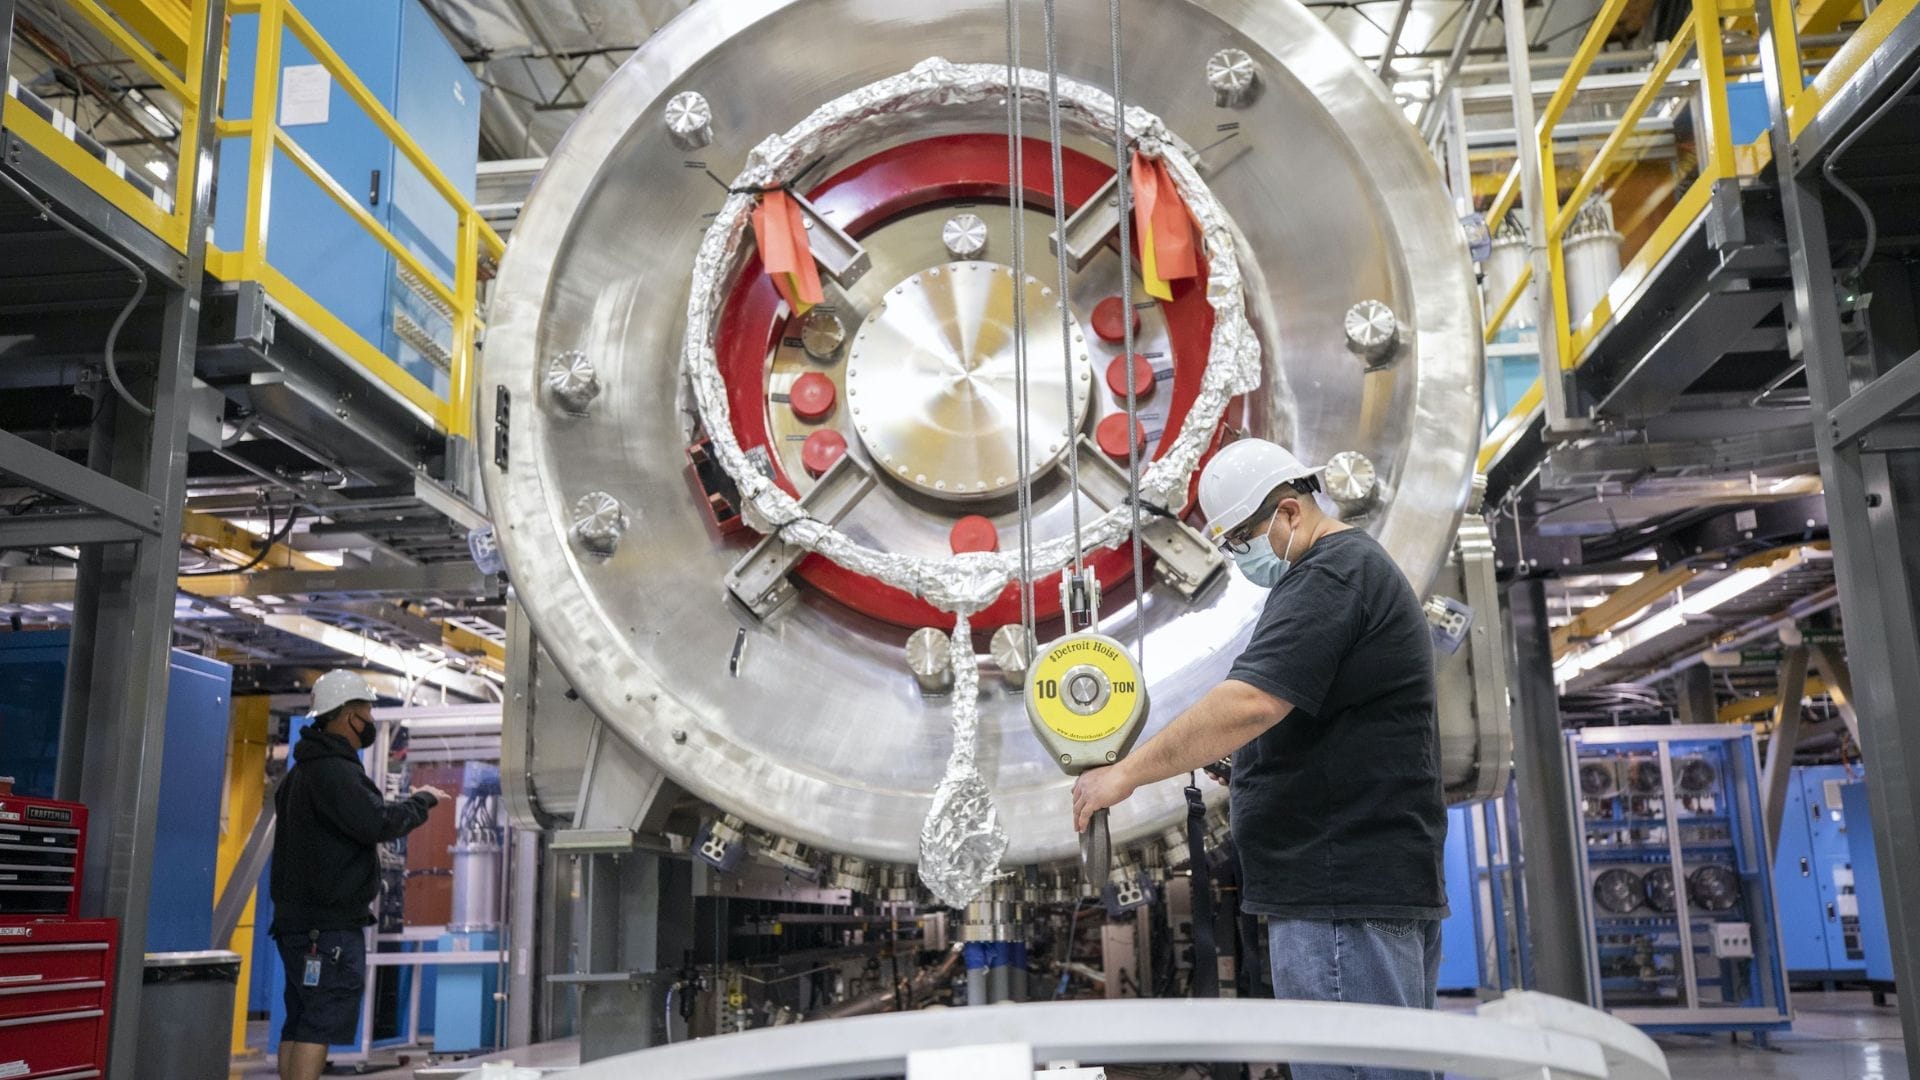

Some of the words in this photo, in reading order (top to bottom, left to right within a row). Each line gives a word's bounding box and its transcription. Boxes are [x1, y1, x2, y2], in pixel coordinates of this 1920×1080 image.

[1054, 641, 1090, 659] Detroit
[1093, 641, 1120, 661] Hoist
[1036, 679, 1057, 699] 10
[1112, 682, 1135, 693] TON
[30, 809, 70, 820] CRAFTSMAN
